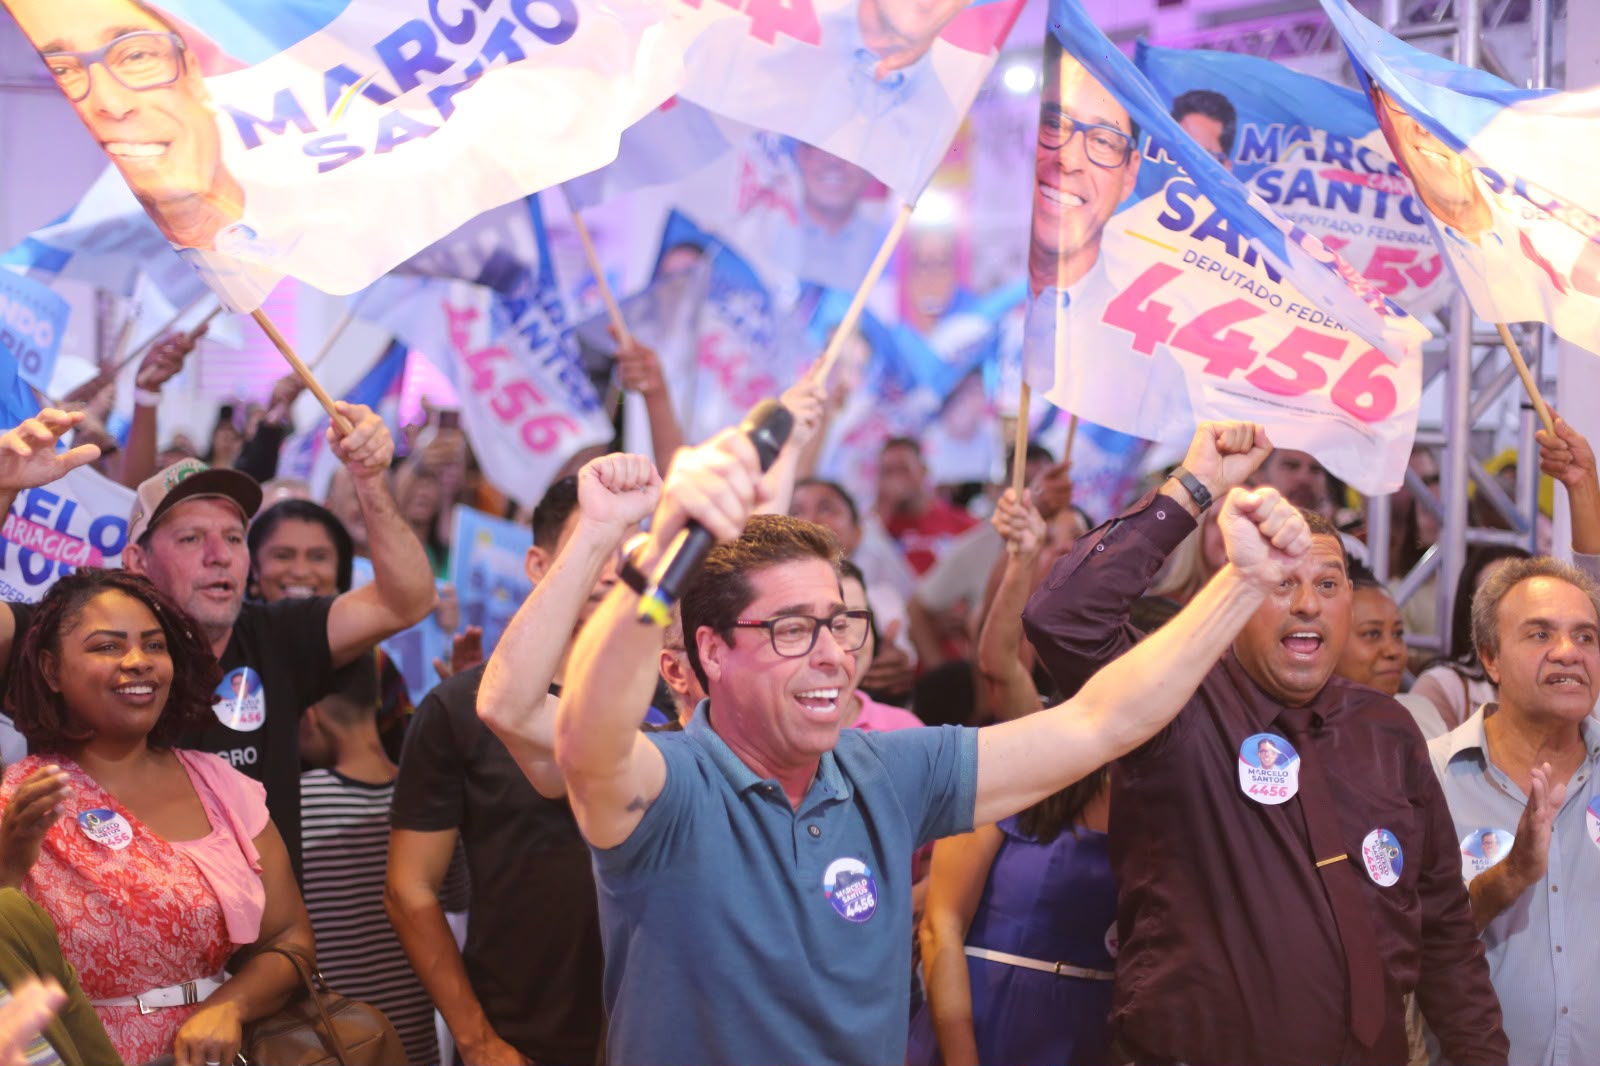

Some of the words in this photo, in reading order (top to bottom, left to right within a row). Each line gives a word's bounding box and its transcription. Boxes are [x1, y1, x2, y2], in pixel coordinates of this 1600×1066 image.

[220, 0, 492, 150] MARC
[1183, 248, 1283, 308] DEPUTADO
[1101, 261, 1400, 424] 4456
[9, 486, 128, 557] ELO
[1248, 768, 1289, 778] MARCELO
[1249, 784, 1289, 798] 4456
[1252, 775, 1285, 784] SANTOS
[847, 893, 875, 917] 4456
